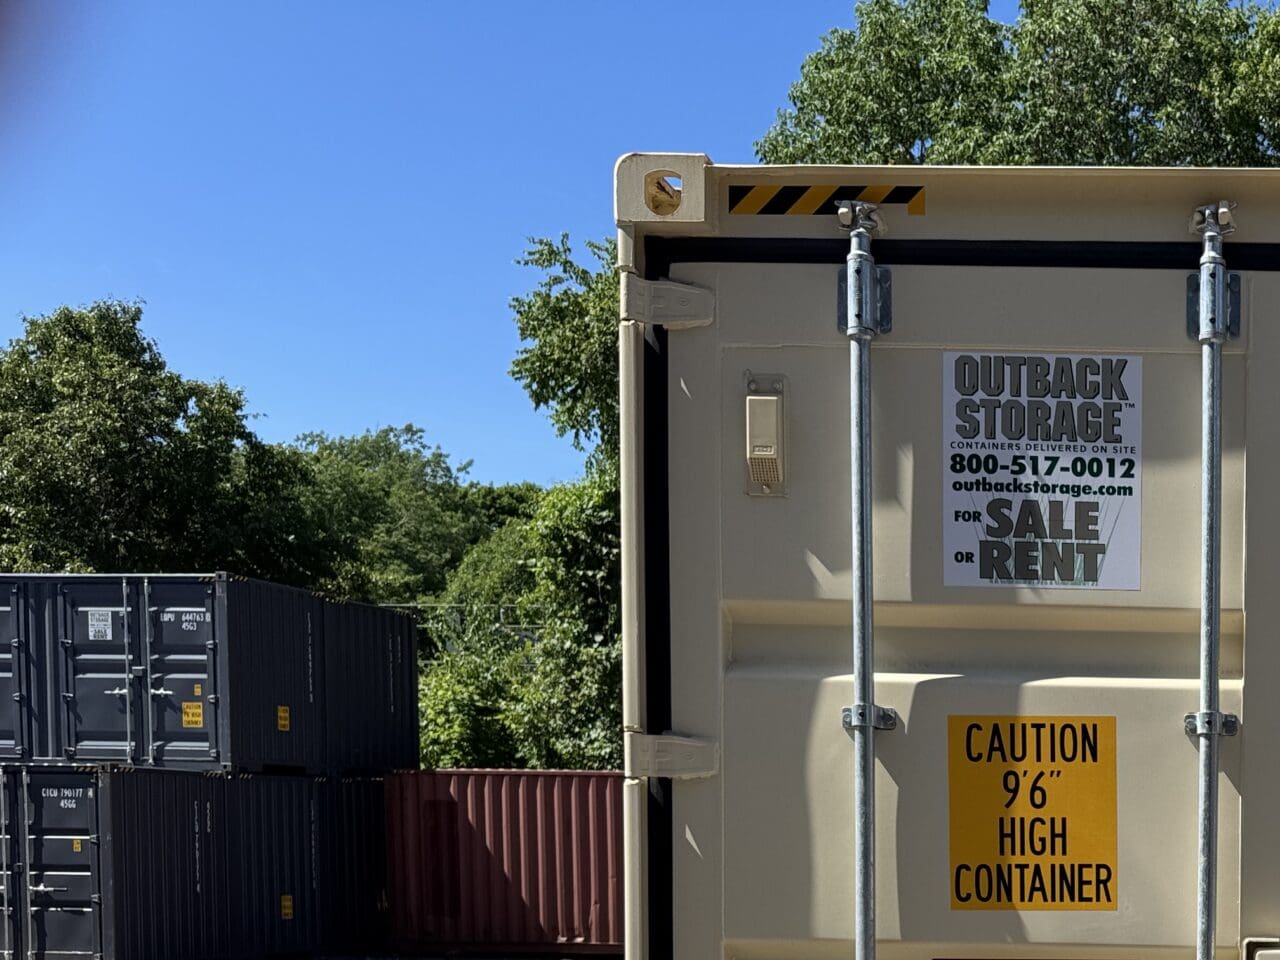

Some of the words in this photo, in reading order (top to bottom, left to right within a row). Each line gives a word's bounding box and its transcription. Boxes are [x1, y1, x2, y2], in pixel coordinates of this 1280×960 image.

[954, 355, 1129, 401] OUTBACK
[955, 398, 1123, 444] STORAGE
[950, 441, 1021, 451] CONTAINERS
[1025, 443, 1087, 454] DELIVERED
[1091, 445, 1108, 455] ON
[1112, 446, 1136, 455] SITE
[950, 453, 1136, 479] 800-517-0012
[952, 477, 1134, 498] outbackstorage.com
[954, 510, 982, 523] FOR
[985, 498, 1101, 541] SALE
[954, 551, 975, 564] OR
[979, 540, 1106, 582] RENT
[965, 723, 1099, 763] CAUTION
[998, 817, 1068, 857] HIGH
[954, 863, 1113, 904] CONTAINER
